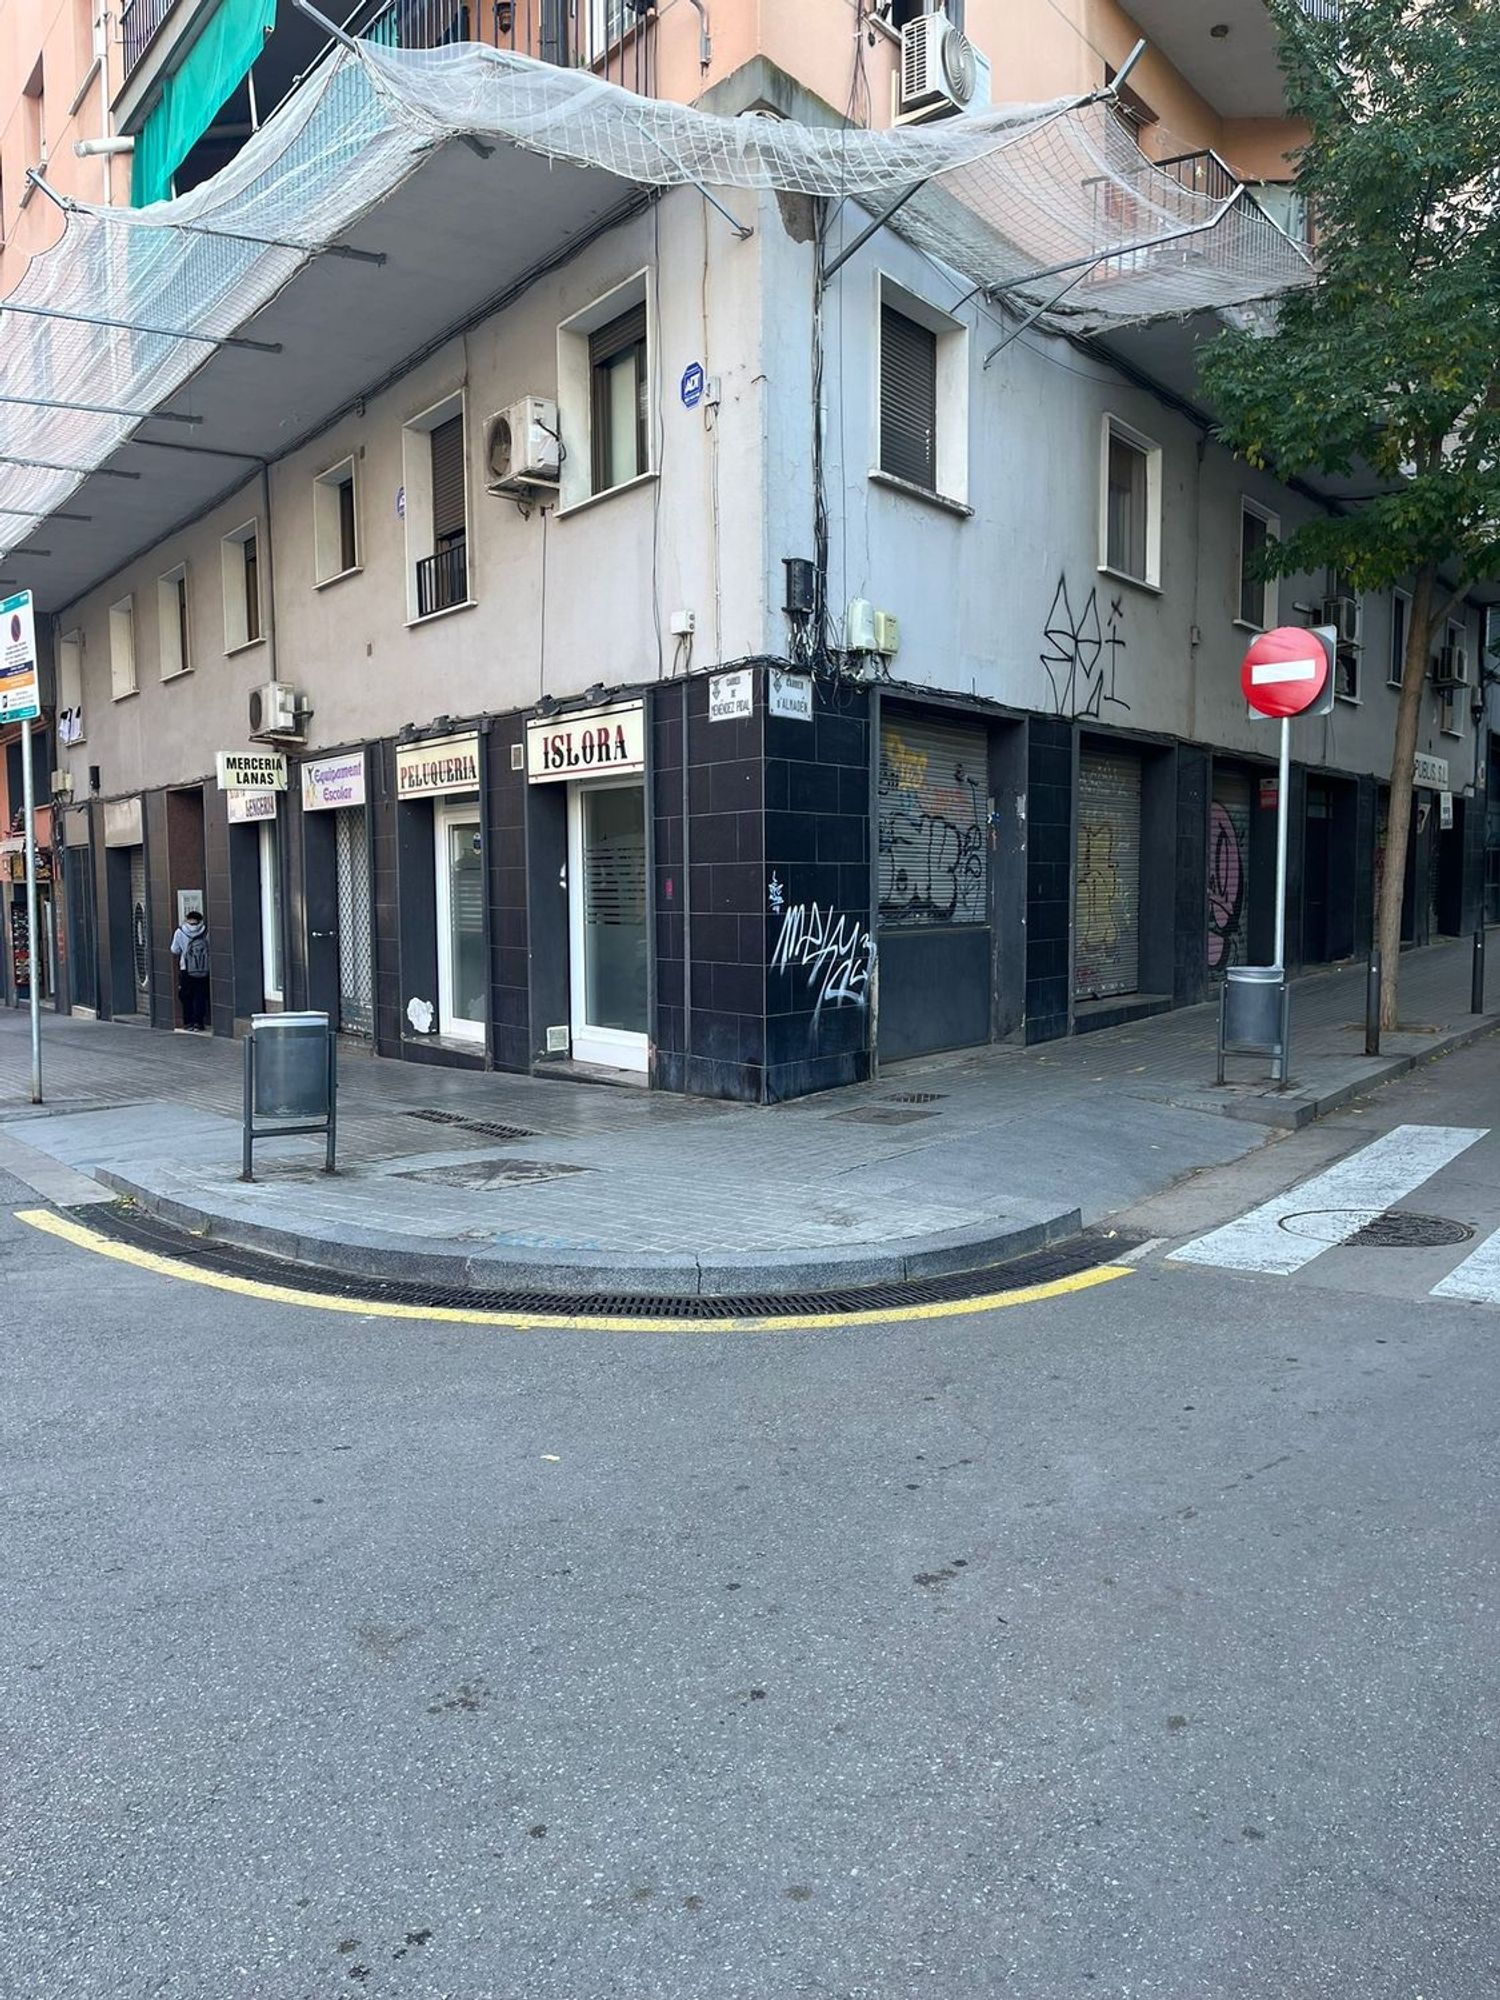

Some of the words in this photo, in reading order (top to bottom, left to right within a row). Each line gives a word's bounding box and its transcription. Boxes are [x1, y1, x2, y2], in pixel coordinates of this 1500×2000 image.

[543, 724, 628, 770] ISLORA
[226, 757, 283, 771] MERCERIA
[314, 760, 362, 784] Equipament
[400, 755, 477, 790] PELUQUERIA
[236, 772, 275, 785] LANAS
[323, 786, 352, 801] Escolar
